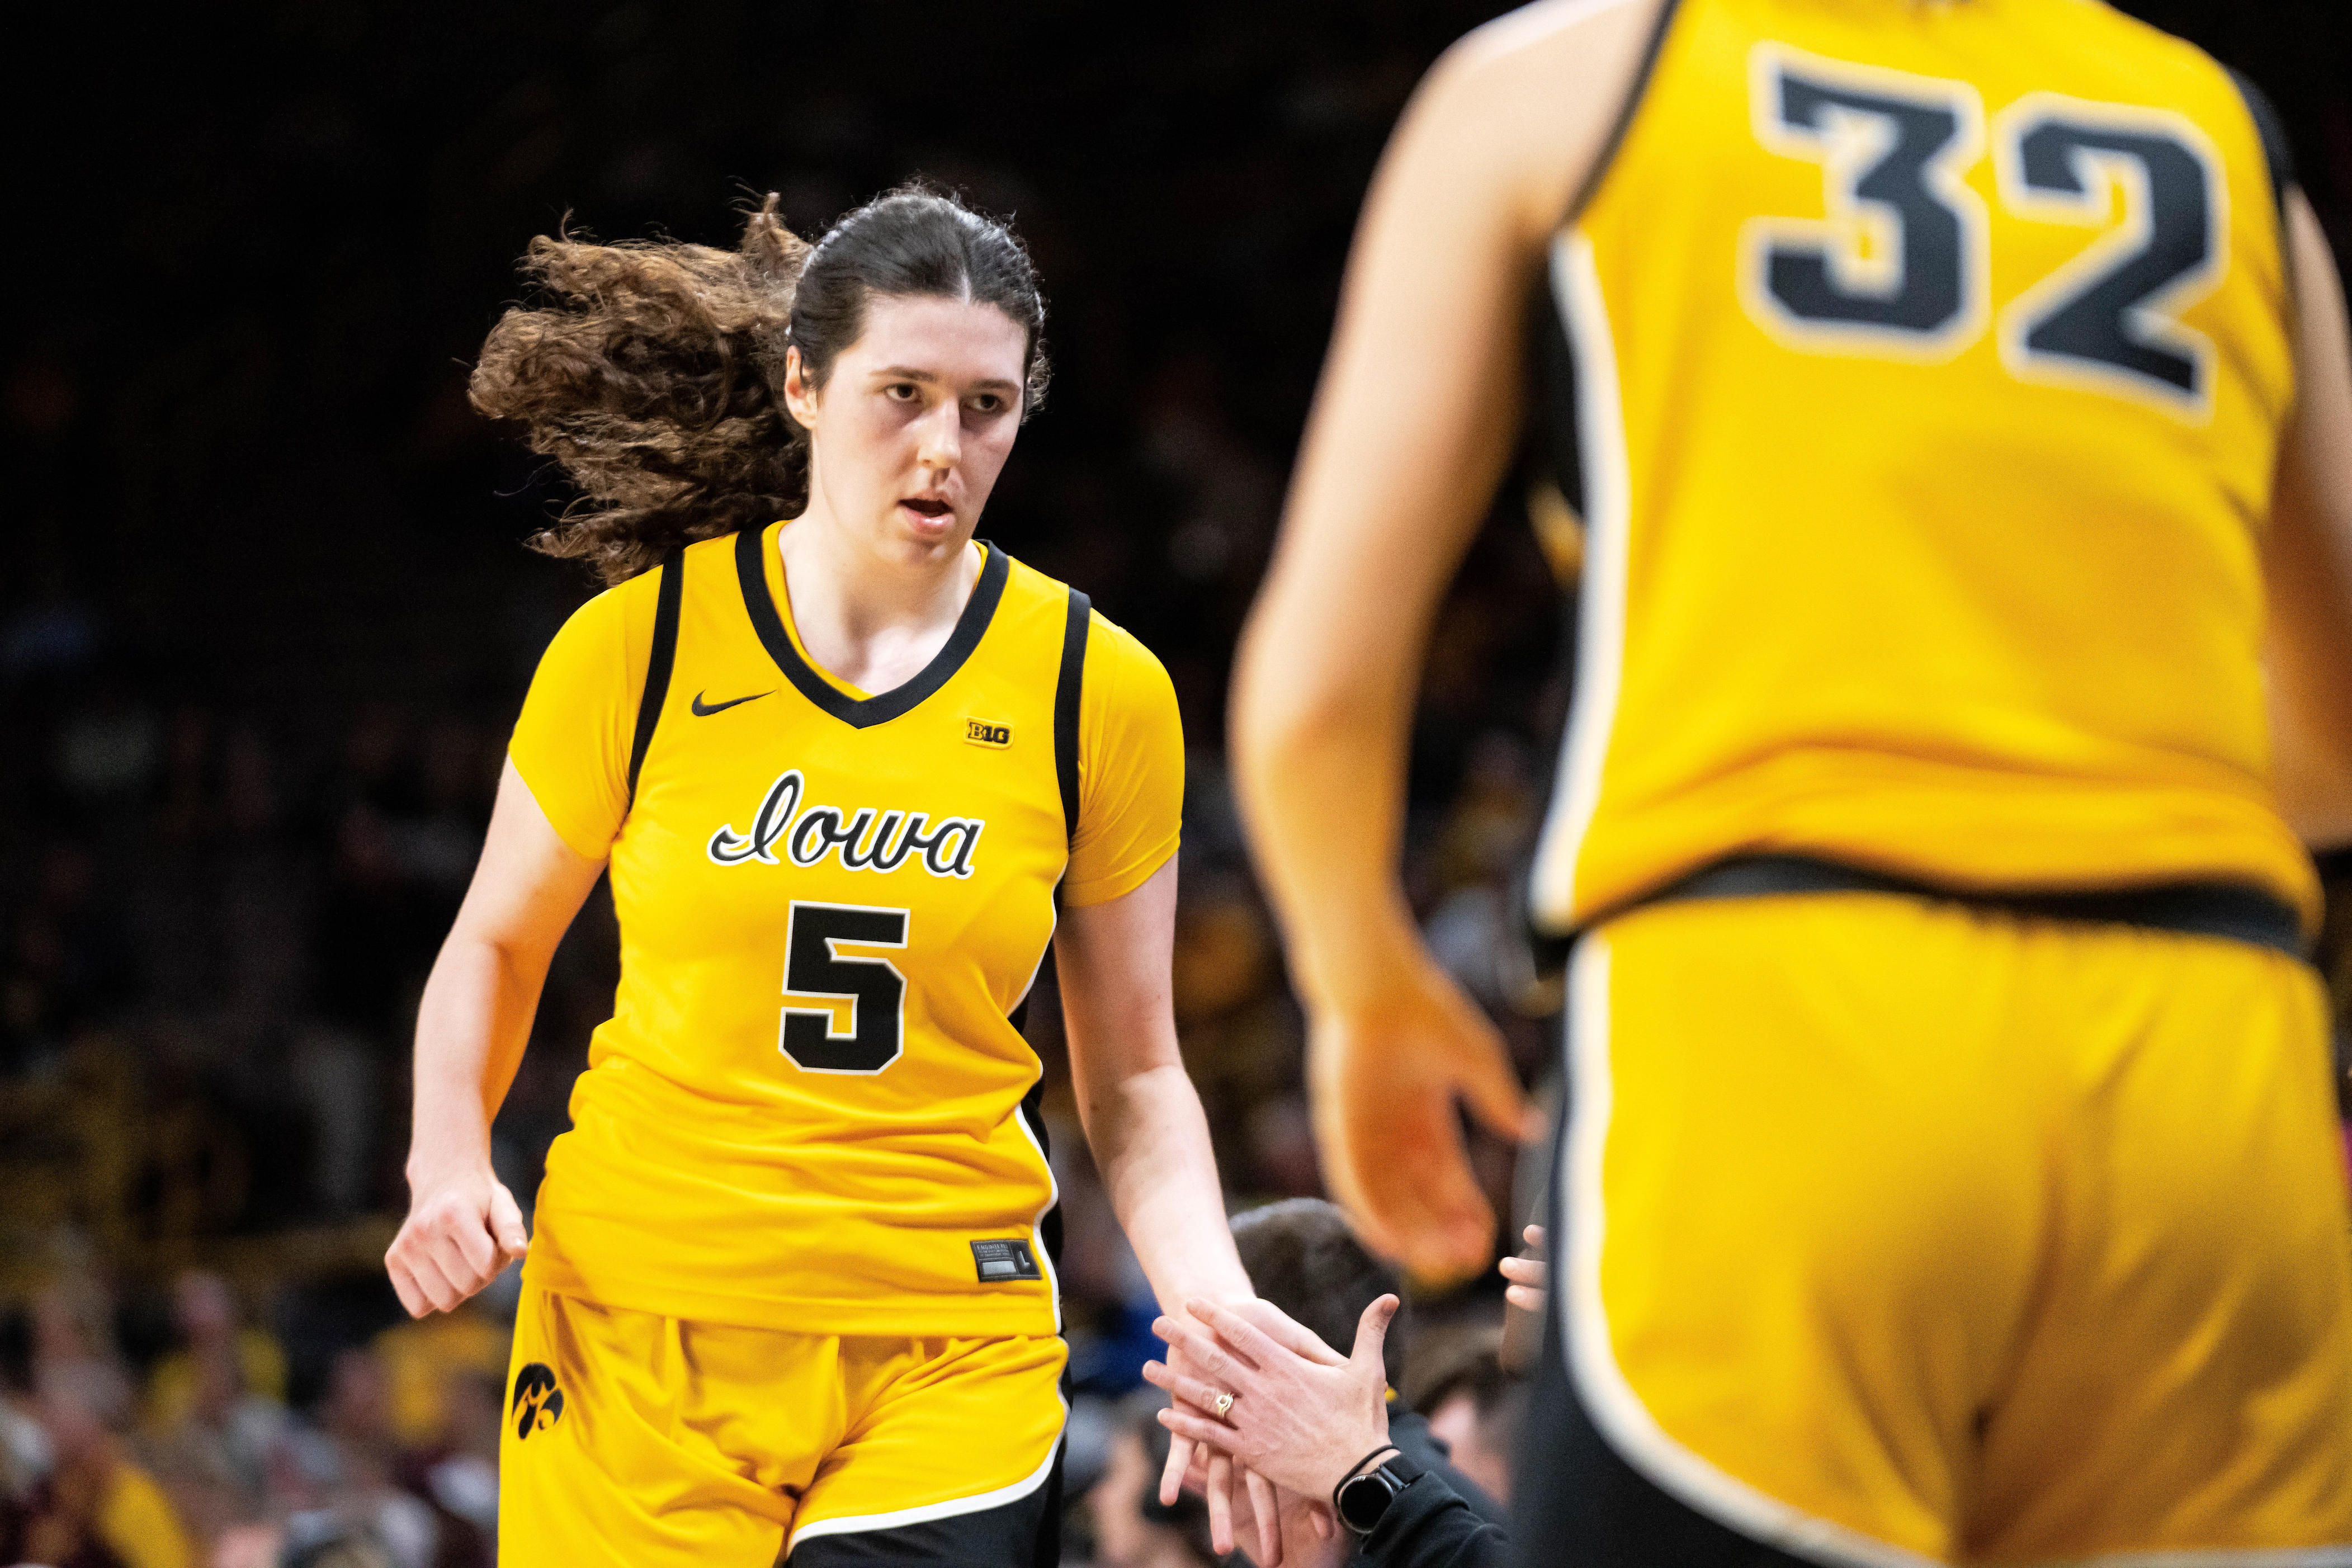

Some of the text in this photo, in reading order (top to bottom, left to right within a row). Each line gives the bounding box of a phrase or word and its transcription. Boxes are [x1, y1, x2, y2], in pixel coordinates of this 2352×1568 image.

[1738, 42, 2228, 424] 32
[707, 769, 985, 880] Iowa
[778, 899, 911, 1076] 5
